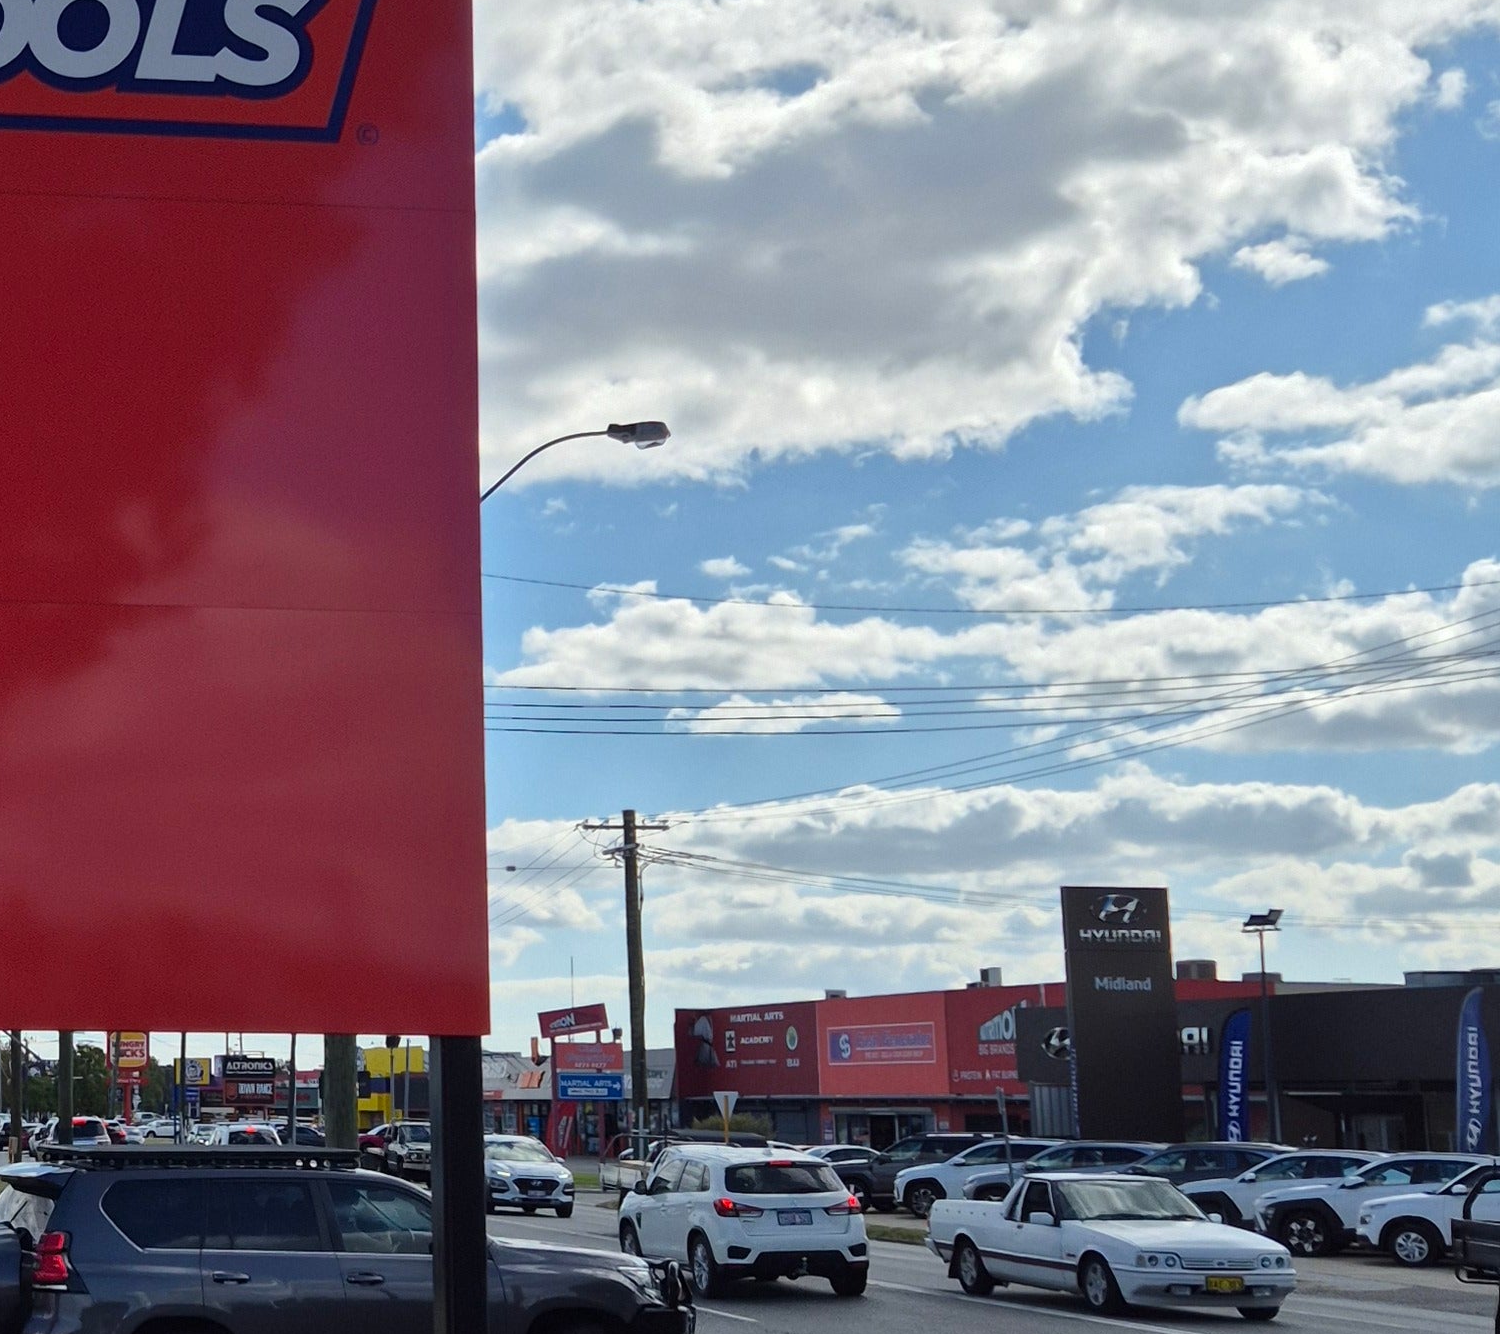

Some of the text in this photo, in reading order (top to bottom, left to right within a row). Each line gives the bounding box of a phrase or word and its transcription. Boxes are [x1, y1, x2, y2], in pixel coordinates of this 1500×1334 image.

[1079, 929, 1161, 943] HYUNDAI
[1094, 977, 1151, 992] Midland
[730, 1011, 784, 1023] MARTIAL ARTS
[226, 1061, 274, 1070] ALTRONICS
[1468, 1026, 1482, 1114] HYUNDAI
[594, 1079, 613, 1087] ARTS
[1228, 1041, 1243, 1117] HYUNDAI
